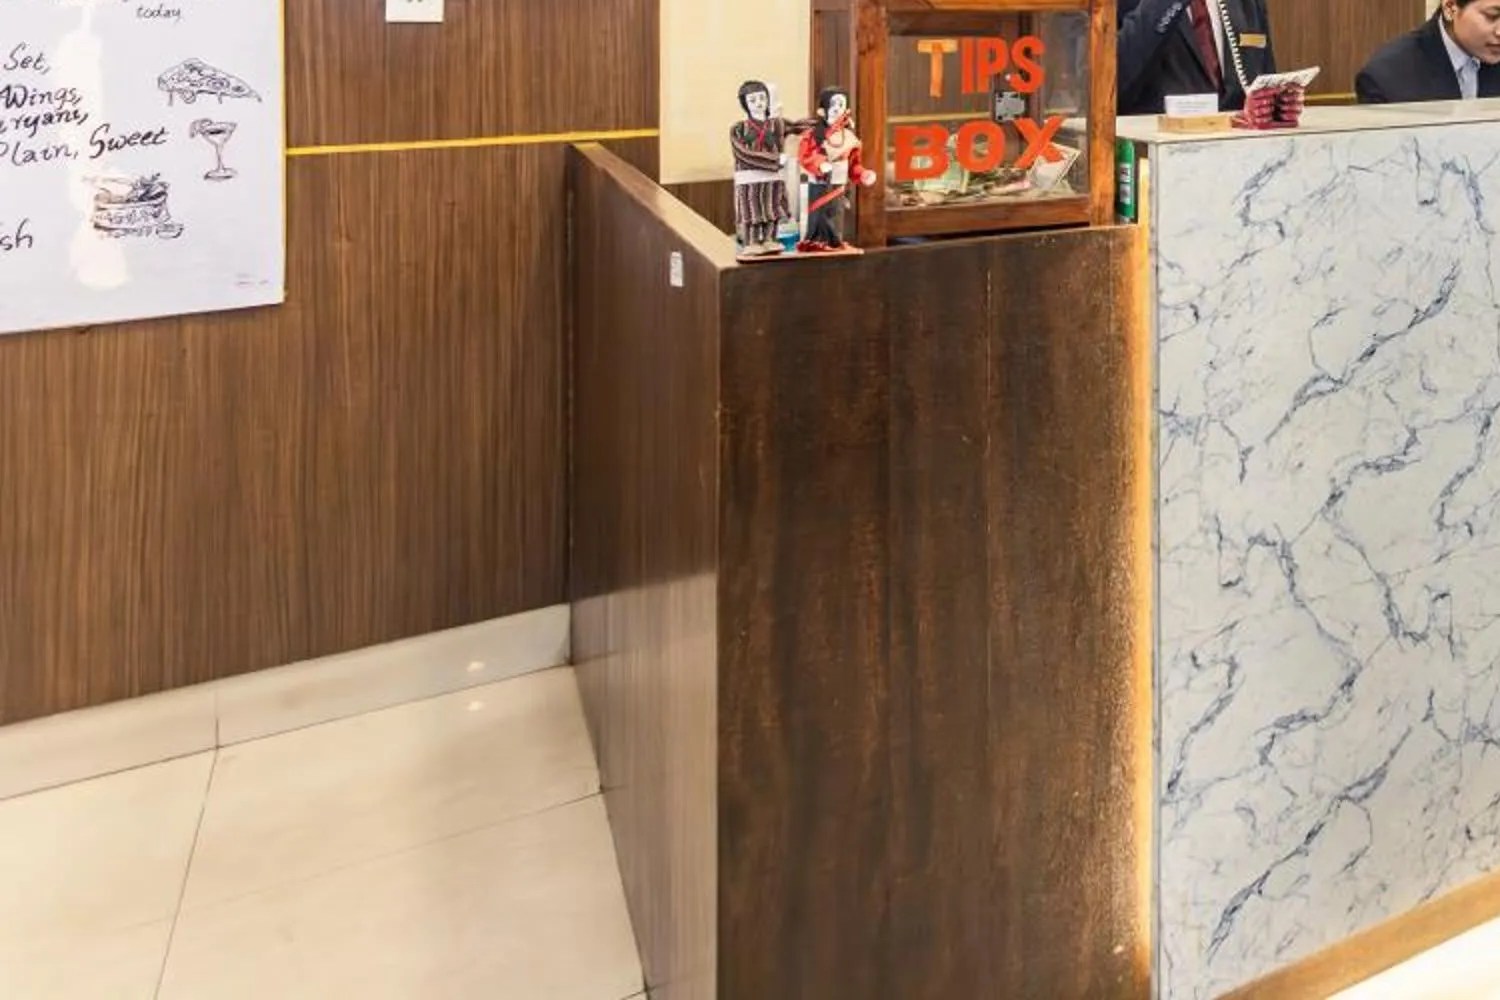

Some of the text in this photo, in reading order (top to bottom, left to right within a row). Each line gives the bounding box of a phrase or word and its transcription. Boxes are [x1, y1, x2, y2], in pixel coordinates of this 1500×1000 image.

[136, 3, 182, 23] today
[3, 42, 52, 75] Set,
[917, 35, 1046, 97] TIPS
[89, 122, 168, 159] Sweet
[893, 114, 1066, 181] BOX
